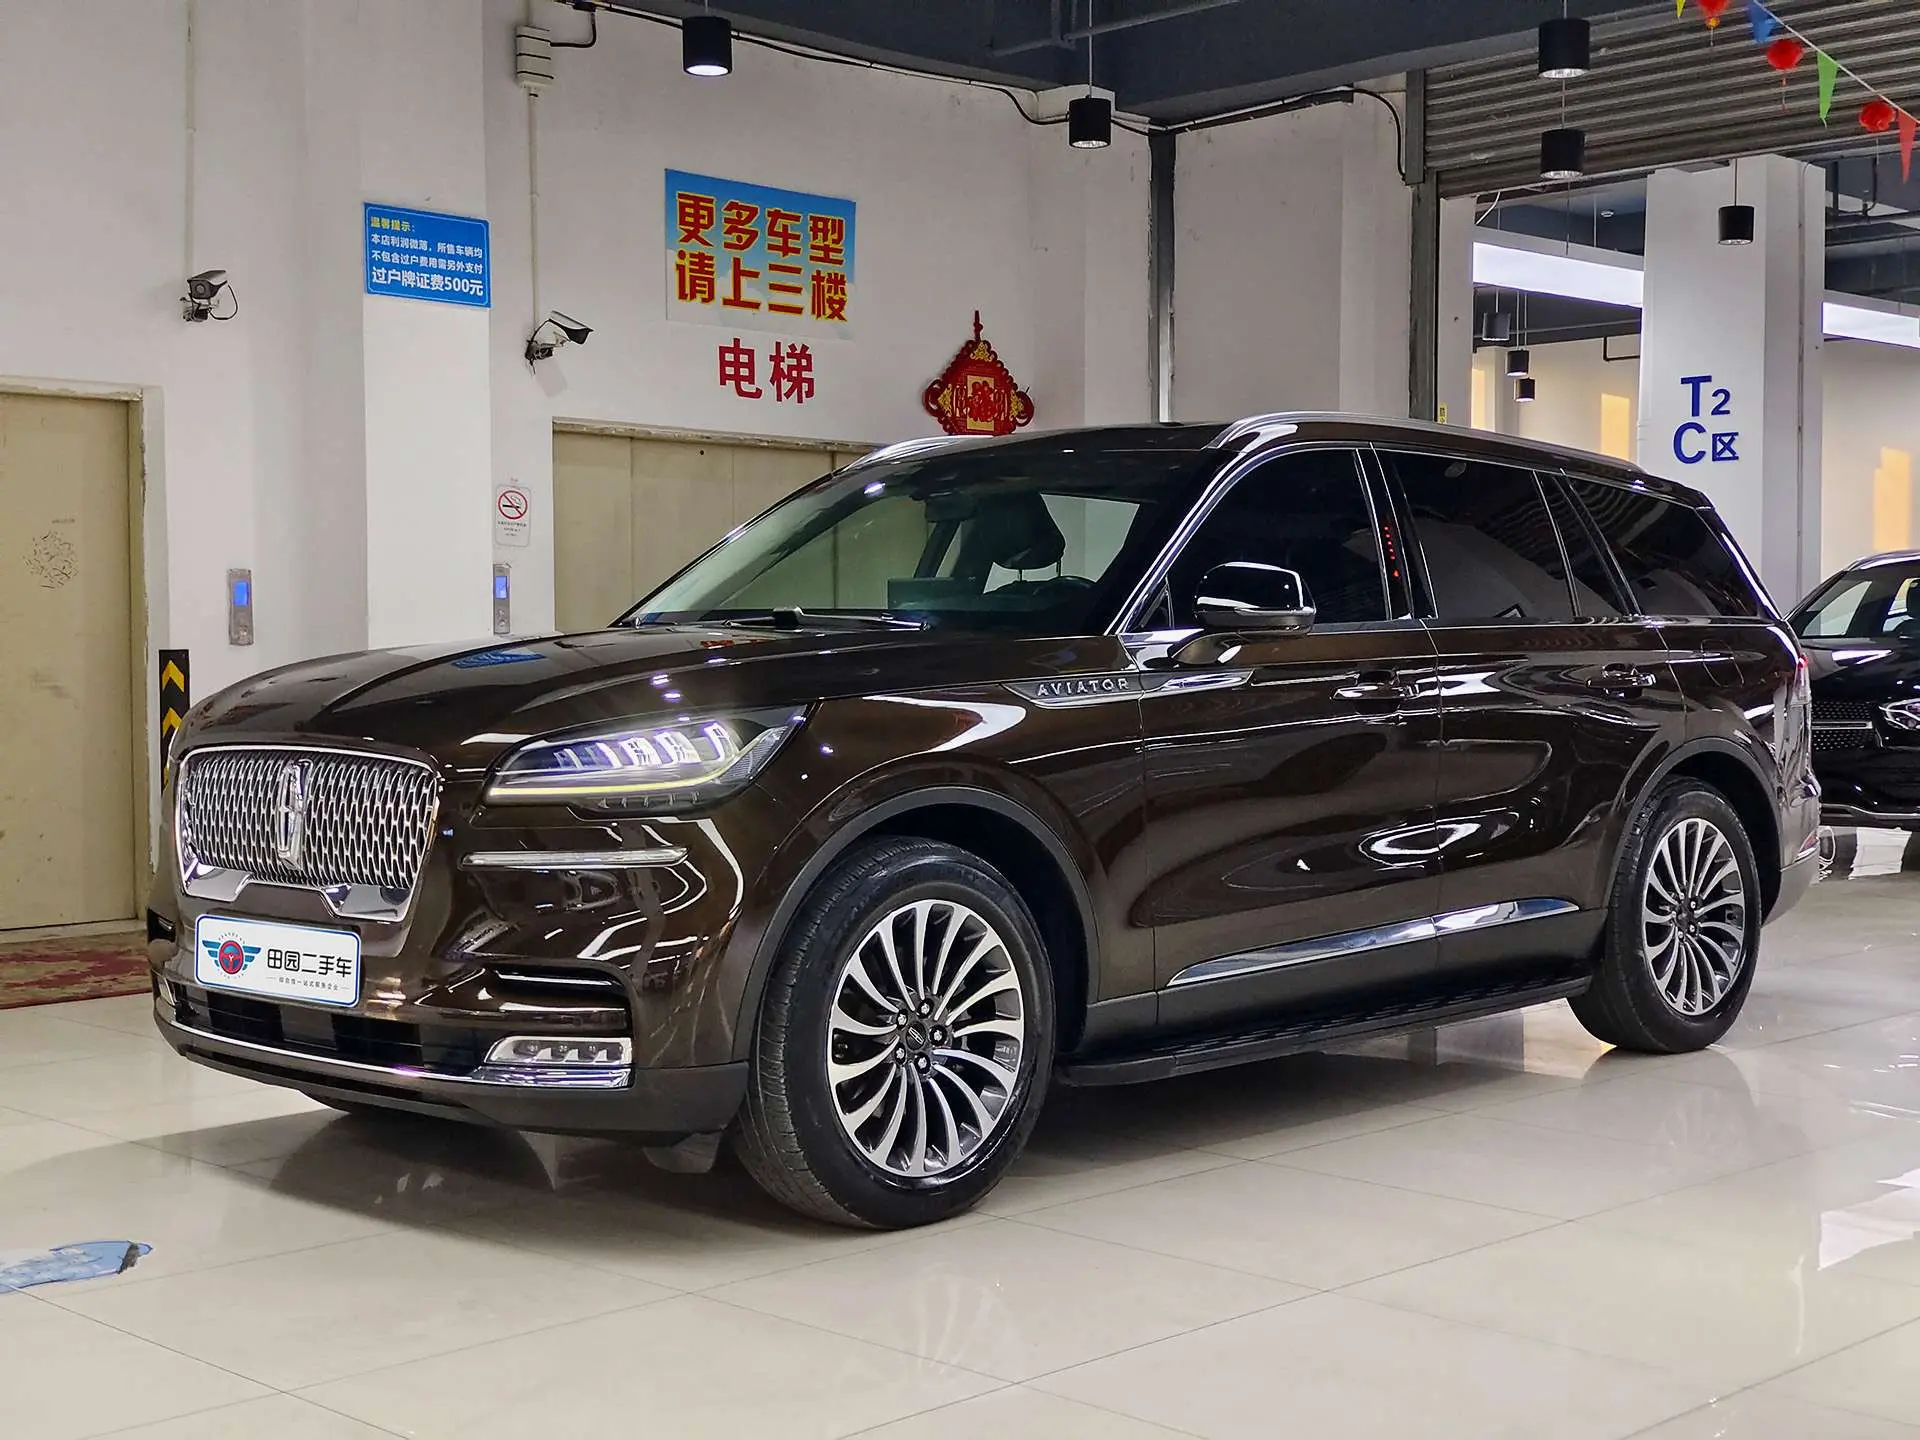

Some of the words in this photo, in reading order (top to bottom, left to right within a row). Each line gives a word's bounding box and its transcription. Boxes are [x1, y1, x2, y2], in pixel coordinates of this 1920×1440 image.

[676, 191, 846, 266] 更多车型
[371, 266, 484, 296] 过户牌证费500元
[675, 249, 848, 322] 请上三楼
[717, 337, 816, 404] 电梯
[1673, 421, 1739, 464] C区
[1036, 677, 1130, 697] AVIATOR
[267, 948, 353, 978] 田园二手车
